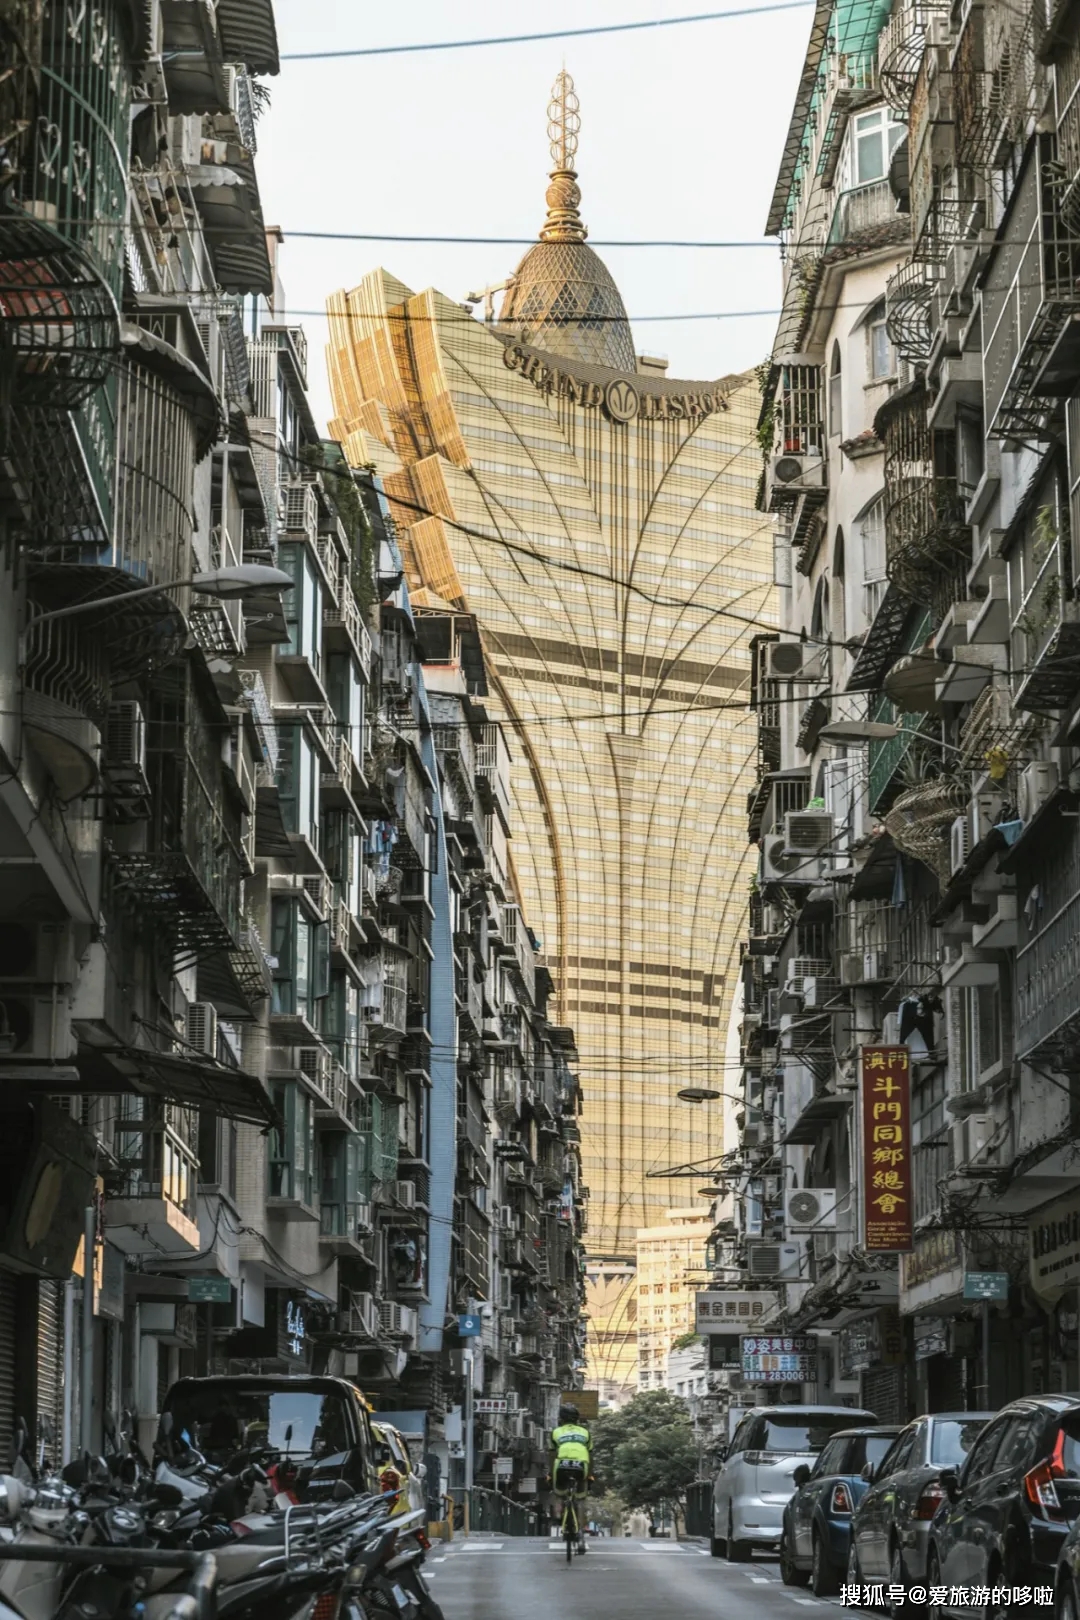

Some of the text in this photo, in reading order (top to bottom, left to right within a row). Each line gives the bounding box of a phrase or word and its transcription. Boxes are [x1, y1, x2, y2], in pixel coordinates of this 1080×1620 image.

[503, 344, 731, 418] GRAND LISBOA
[865, 1051, 908, 1070] 澳門
[872, 1077, 906, 1214] 斗門同鄉總會
[743, 1338, 816, 1355] 妙姿美容中心
[769, 1371, 816, 1380] 28300618
